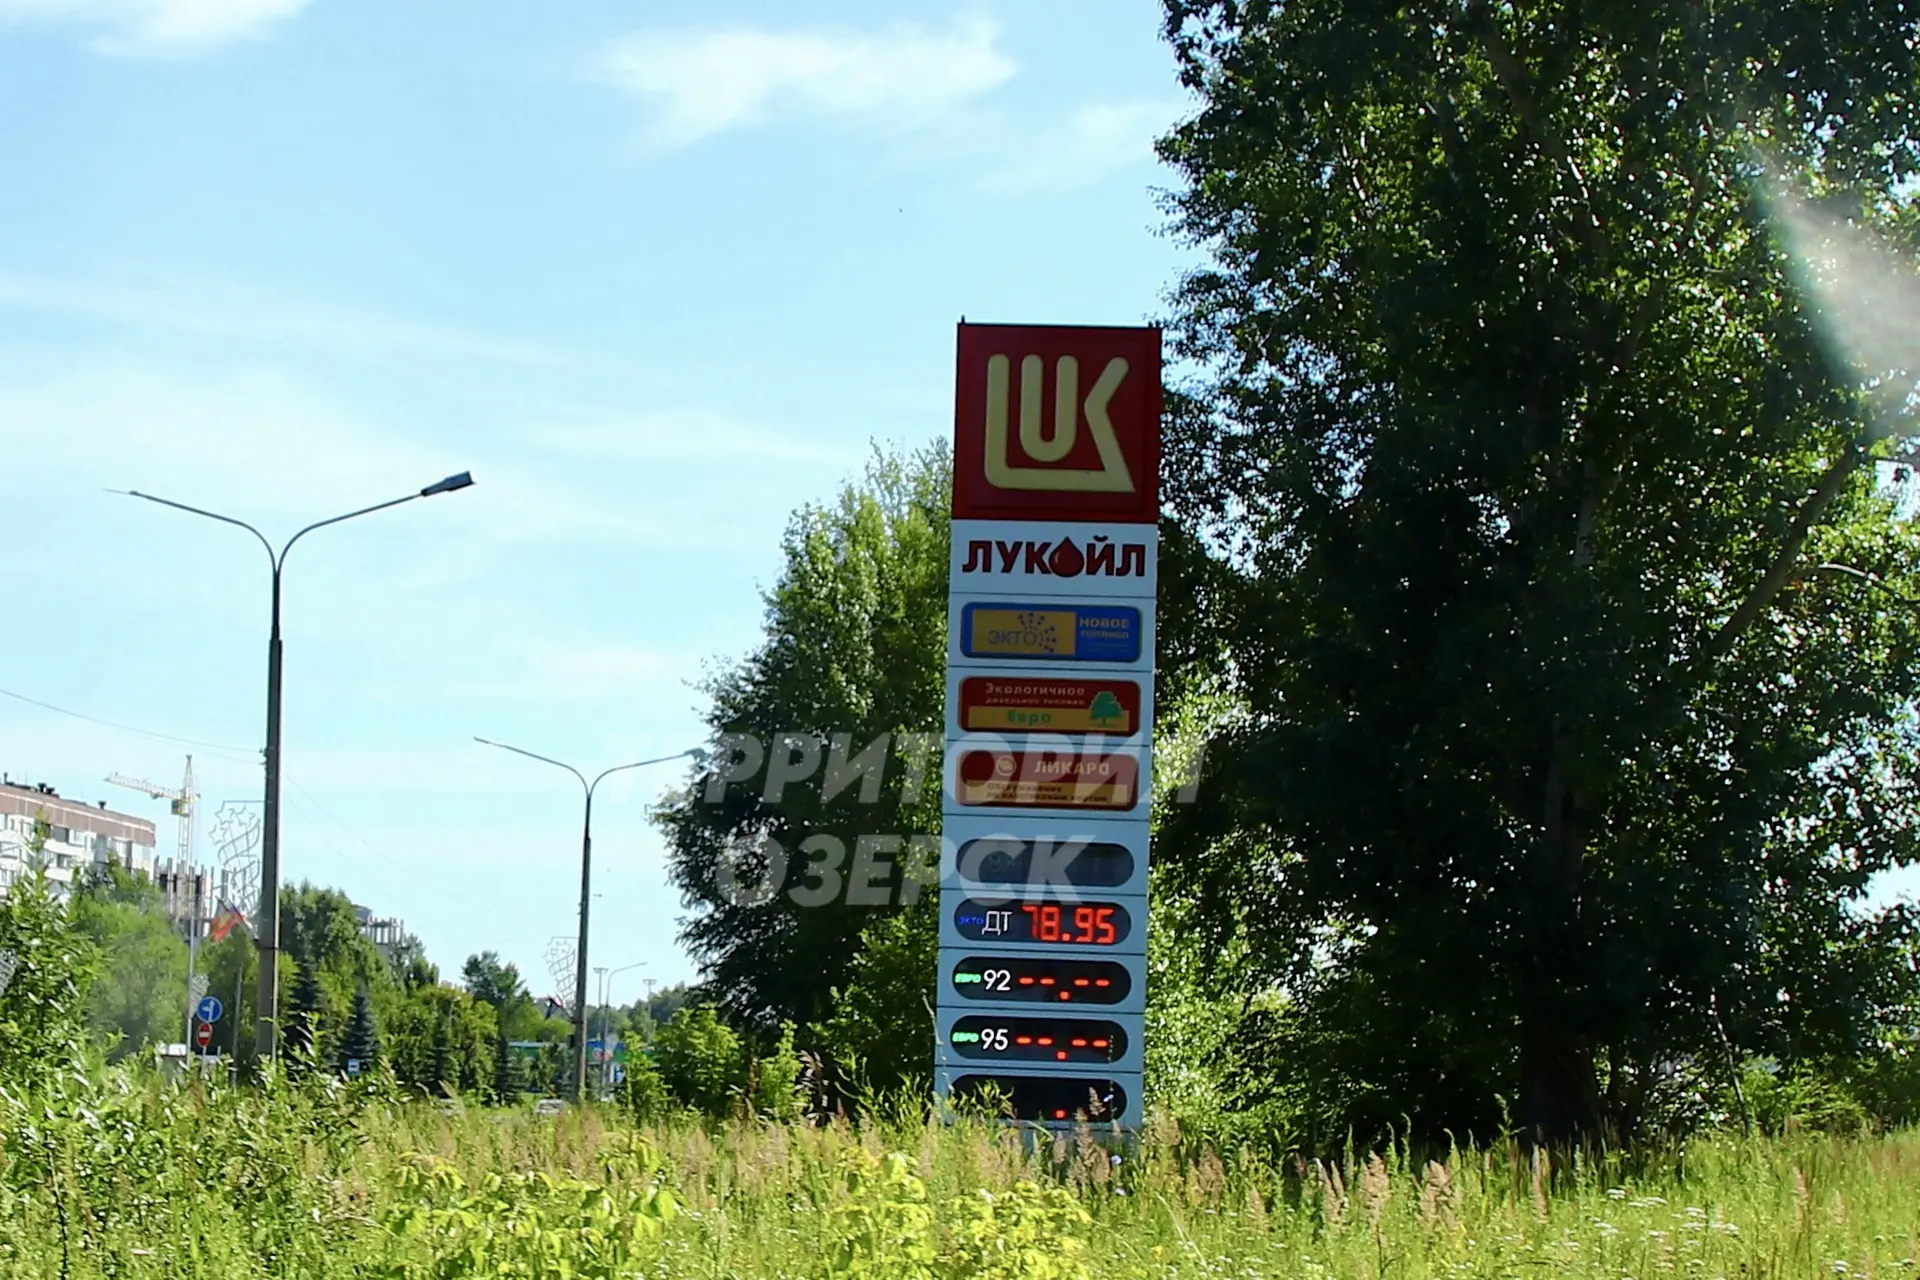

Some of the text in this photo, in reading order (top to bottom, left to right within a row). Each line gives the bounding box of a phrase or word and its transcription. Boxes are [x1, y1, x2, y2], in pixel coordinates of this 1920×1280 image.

[962, 535, 1146, 578] ЛУКОЙЛ
[1079, 617, 1130, 629] НОВОЕ
[988, 629, 1038, 647] ЭКТО
[985, 682, 1086, 697] Экологичное
[981, 910, 1013, 936] ДТ
[1021, 904, 1116, 944] 78.95
[983, 969, 1011, 991] 92
[981, 1028, 1009, 1051] 95
